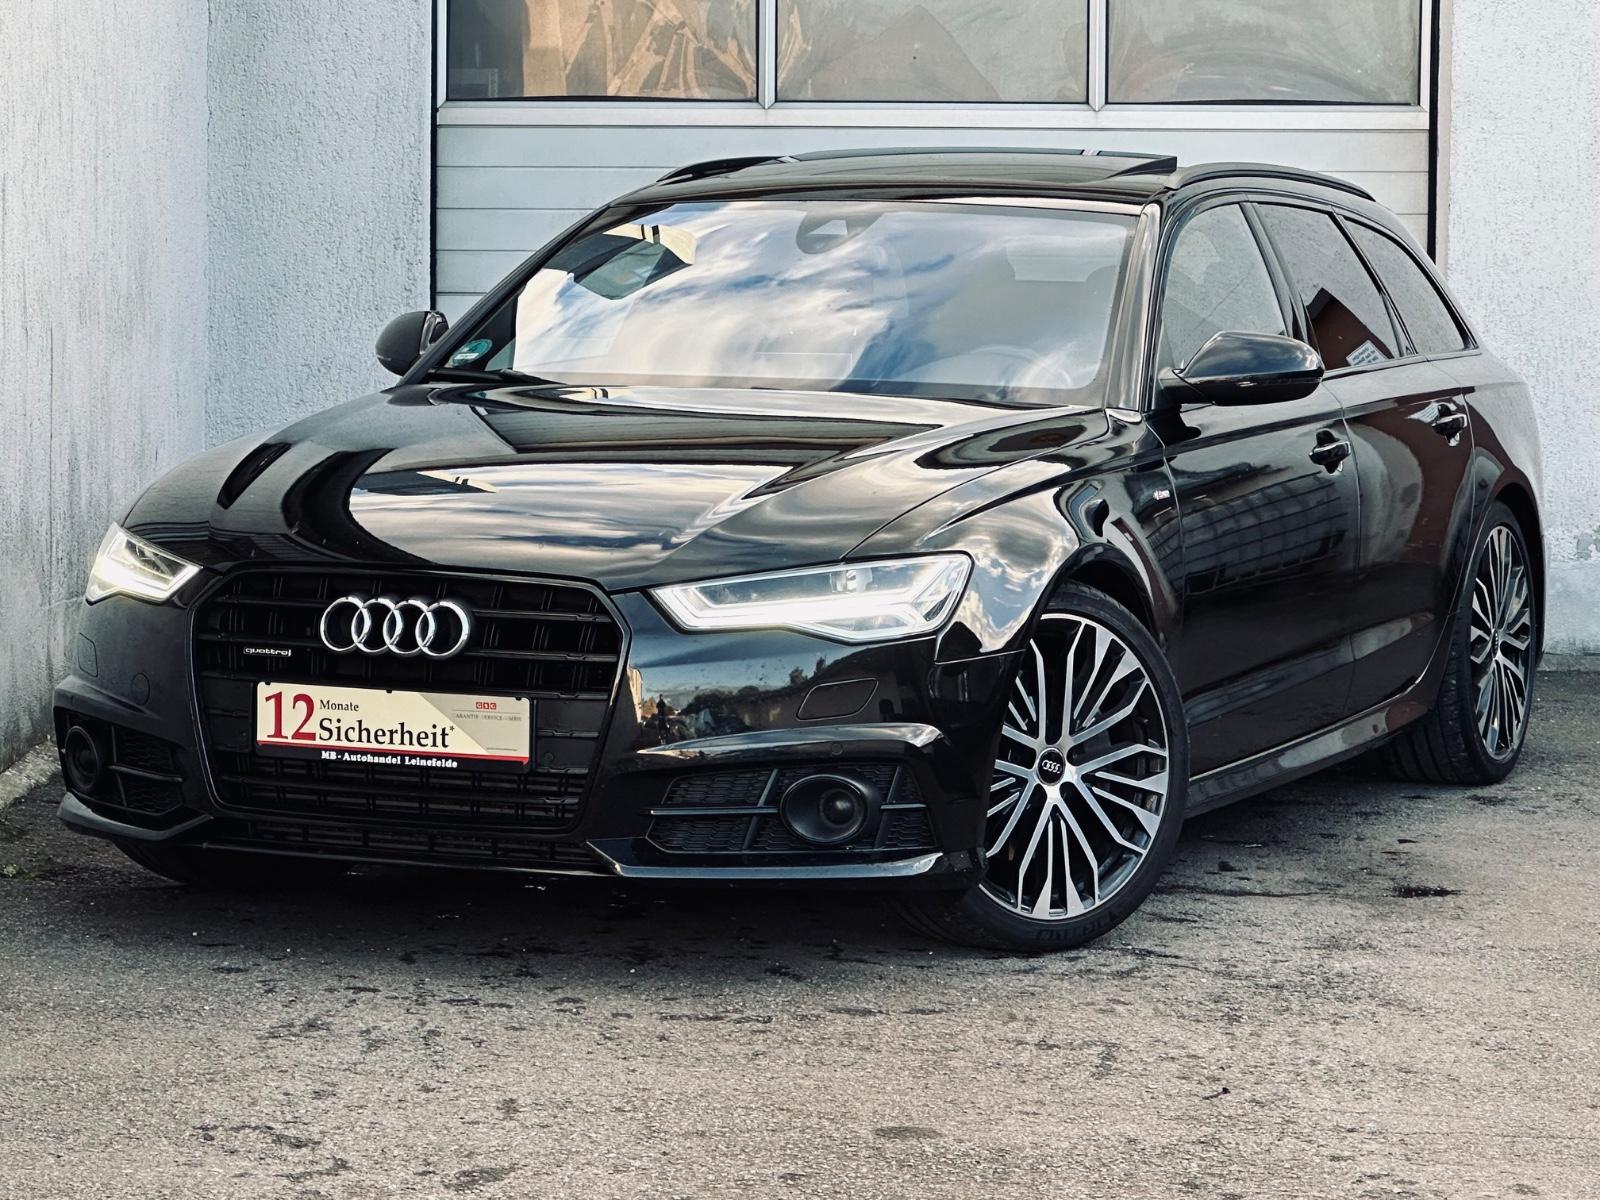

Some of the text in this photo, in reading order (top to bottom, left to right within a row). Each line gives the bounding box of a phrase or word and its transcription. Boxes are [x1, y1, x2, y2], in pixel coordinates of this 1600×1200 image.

[244, 647, 289, 656] quattro
[265, 691, 360, 741] 12 Monate
[404, 756, 458, 768] Leinefelde
